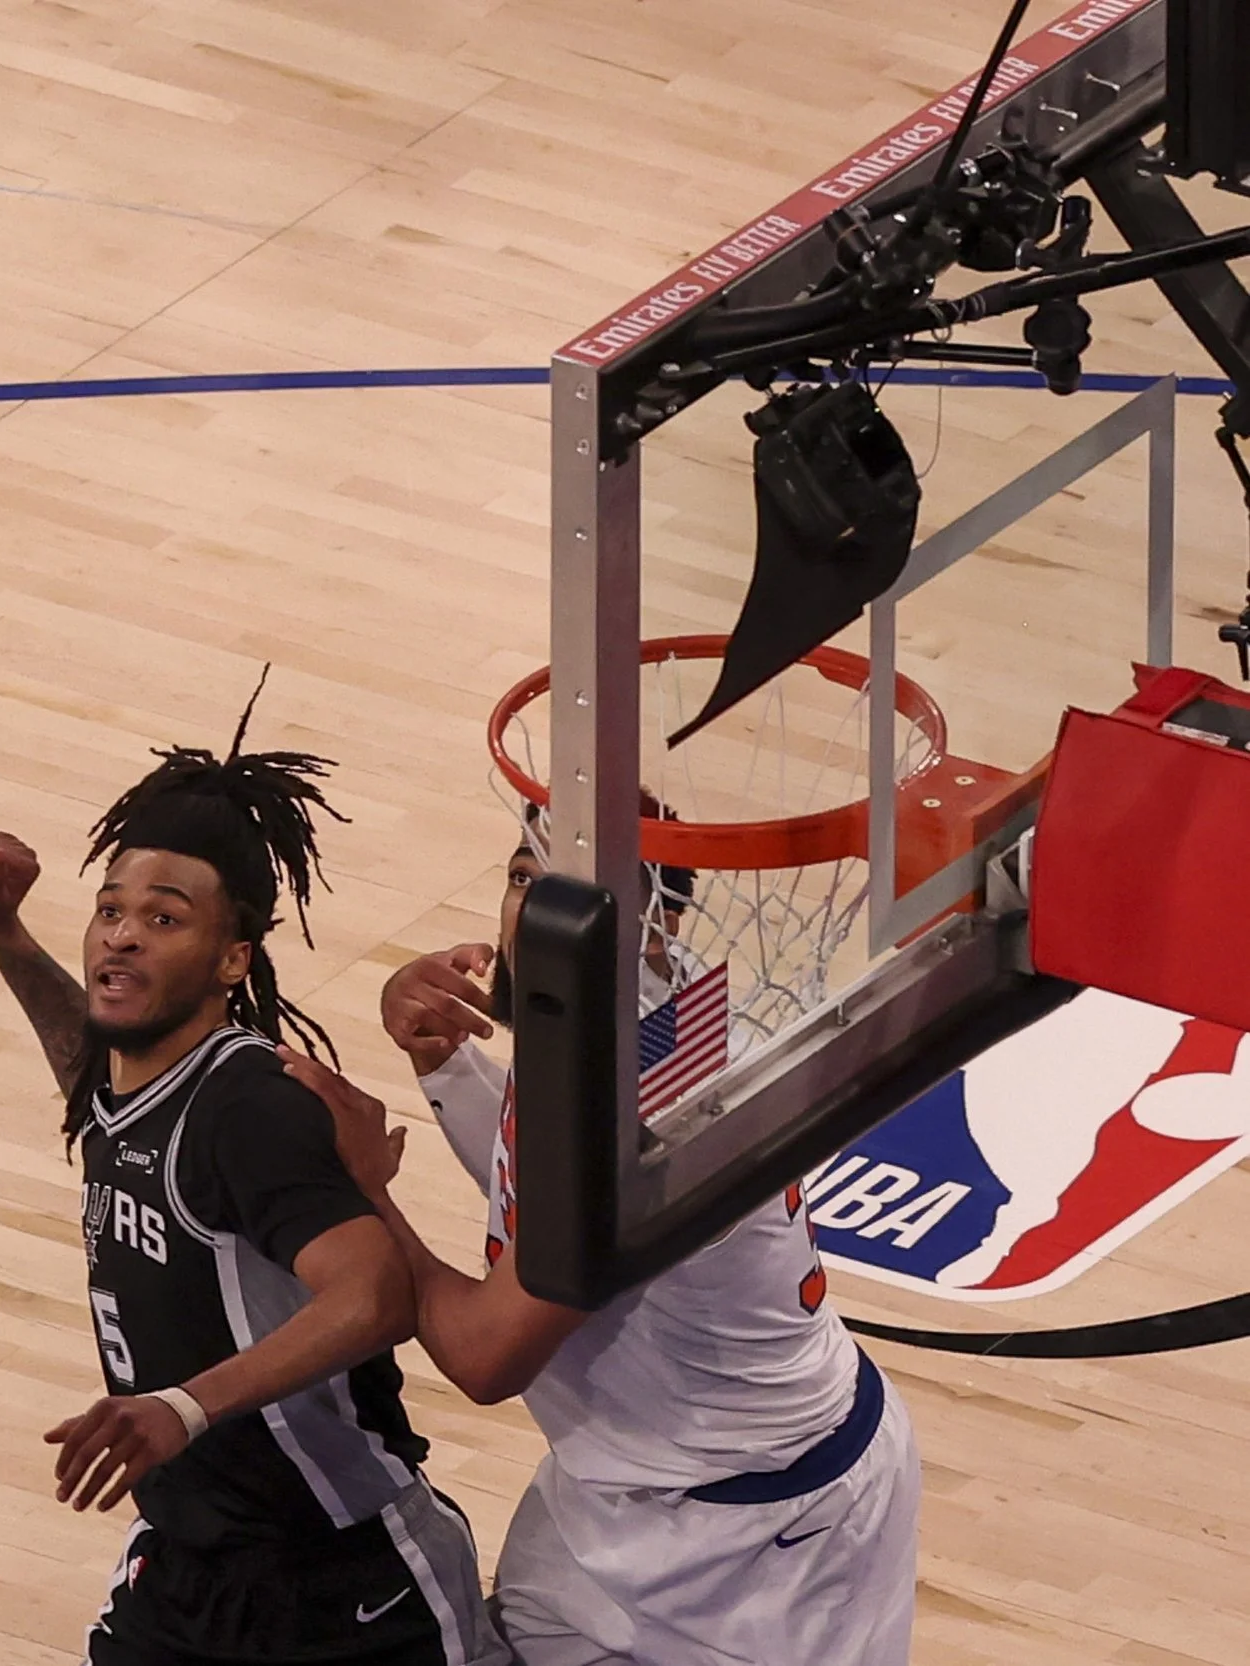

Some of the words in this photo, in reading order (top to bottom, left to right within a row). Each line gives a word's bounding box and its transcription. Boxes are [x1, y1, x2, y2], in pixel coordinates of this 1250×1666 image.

[810, 120, 944, 201] Emirates
[570, 281, 706, 360] Emirates
[690, 254, 740, 284] FLY
[722, 214, 803, 262] BETTER
[82, 1182, 168, 1266] URS
[89, 1285, 137, 1388] 5
